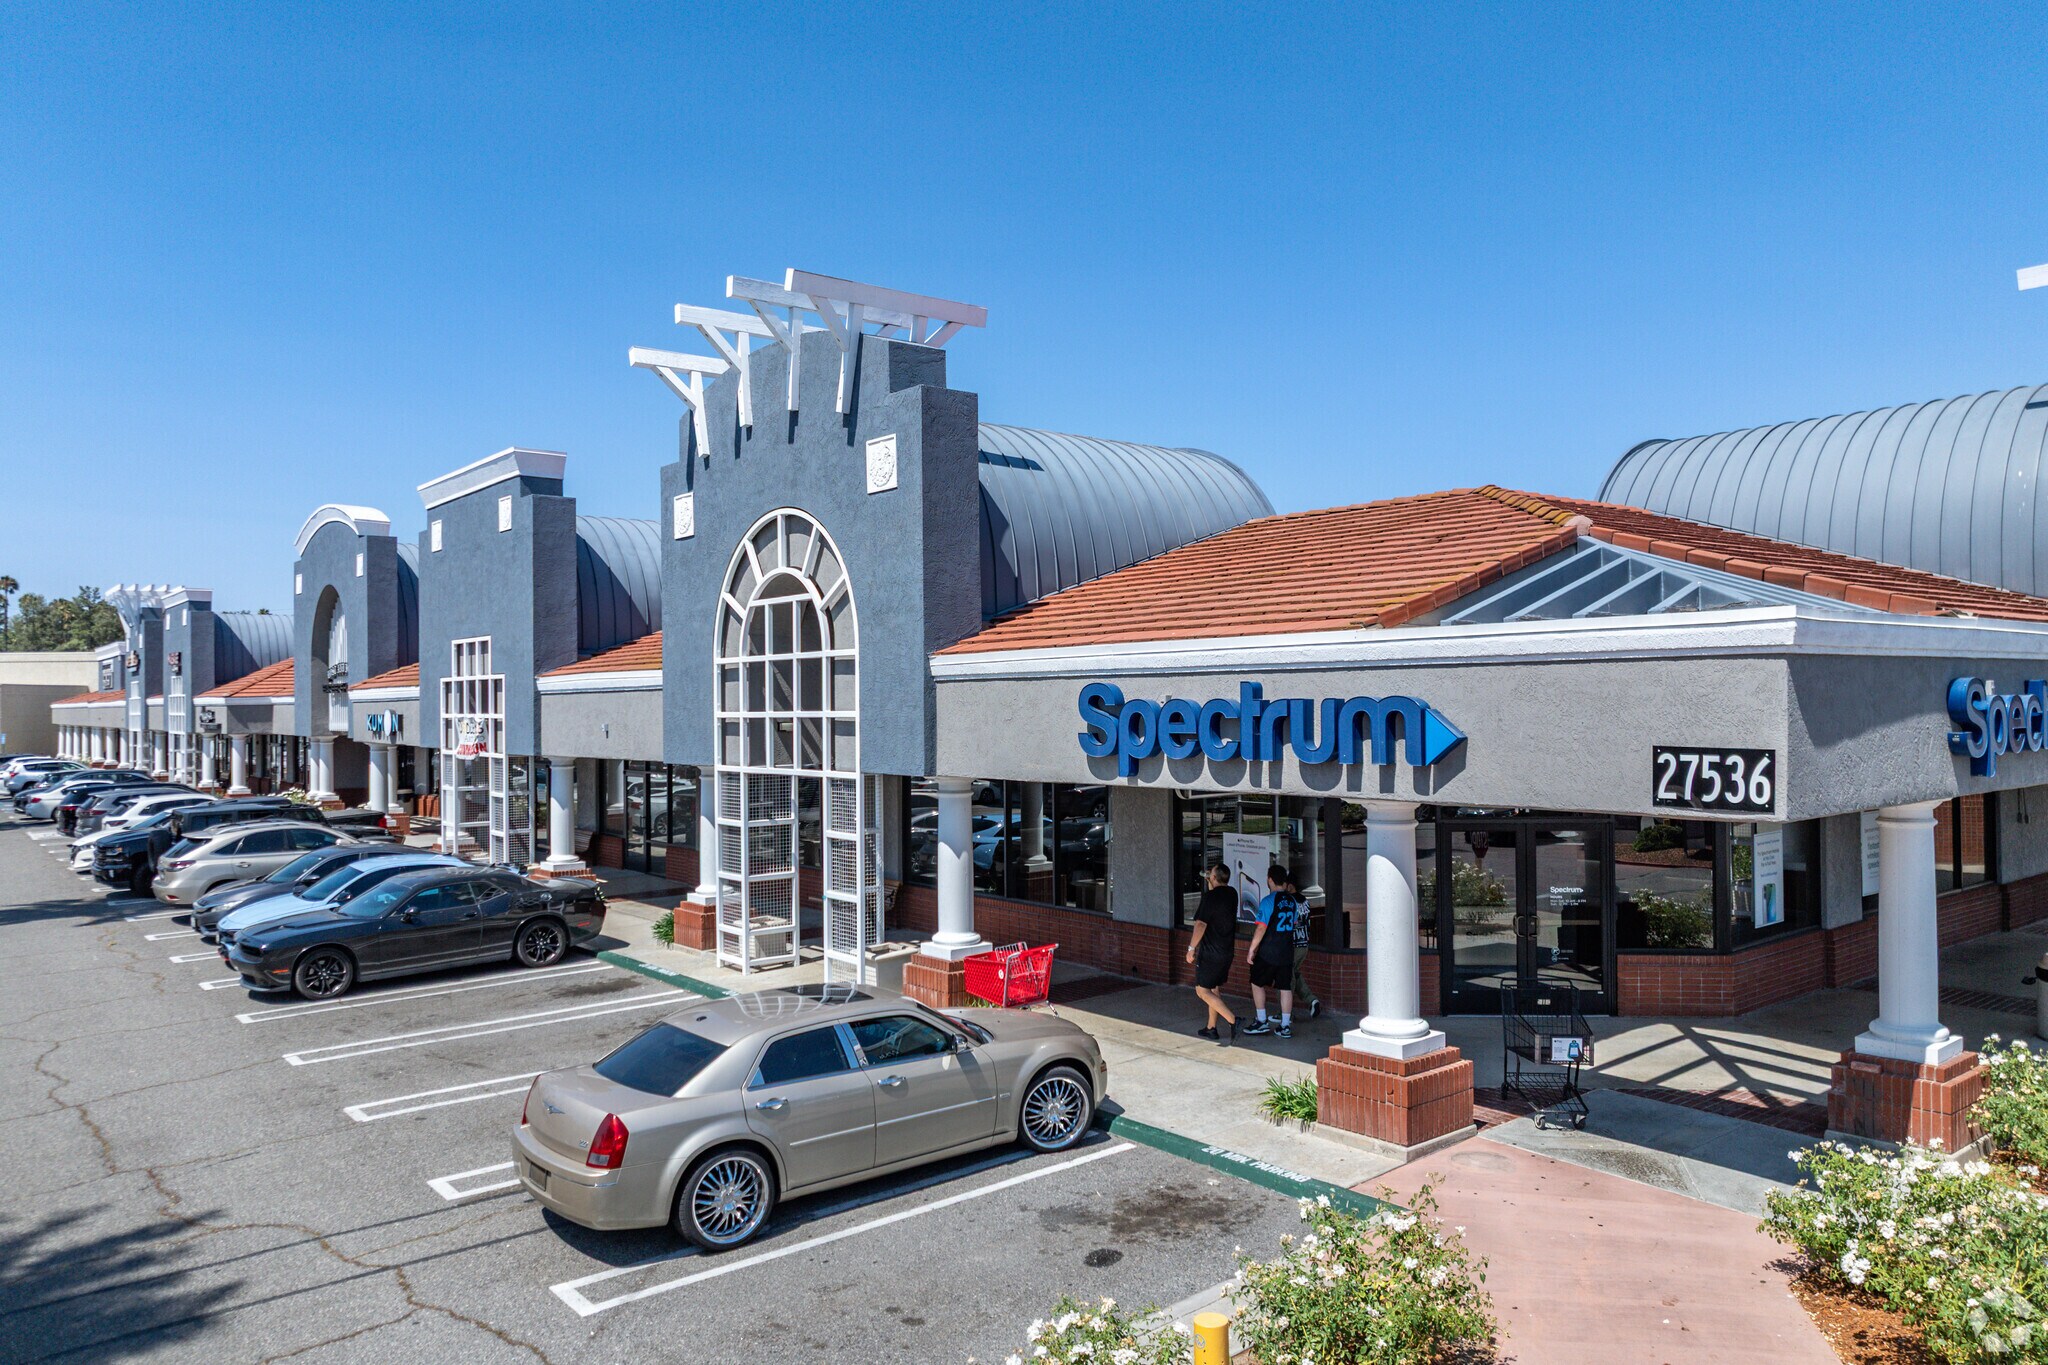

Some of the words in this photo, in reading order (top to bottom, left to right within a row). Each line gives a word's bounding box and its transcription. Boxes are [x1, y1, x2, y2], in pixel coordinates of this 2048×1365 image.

[367, 709, 399, 736] KUMON
[1078, 681, 1429, 777] Spectrum
[1657, 753, 1771, 805] 27536
[1550, 886, 1581, 894] Spectrum
[1276, 911, 1293, 931] 23
[1201, 1145, 1224, 1155] 20
[1249, 1161, 1312, 1183] PARKING
